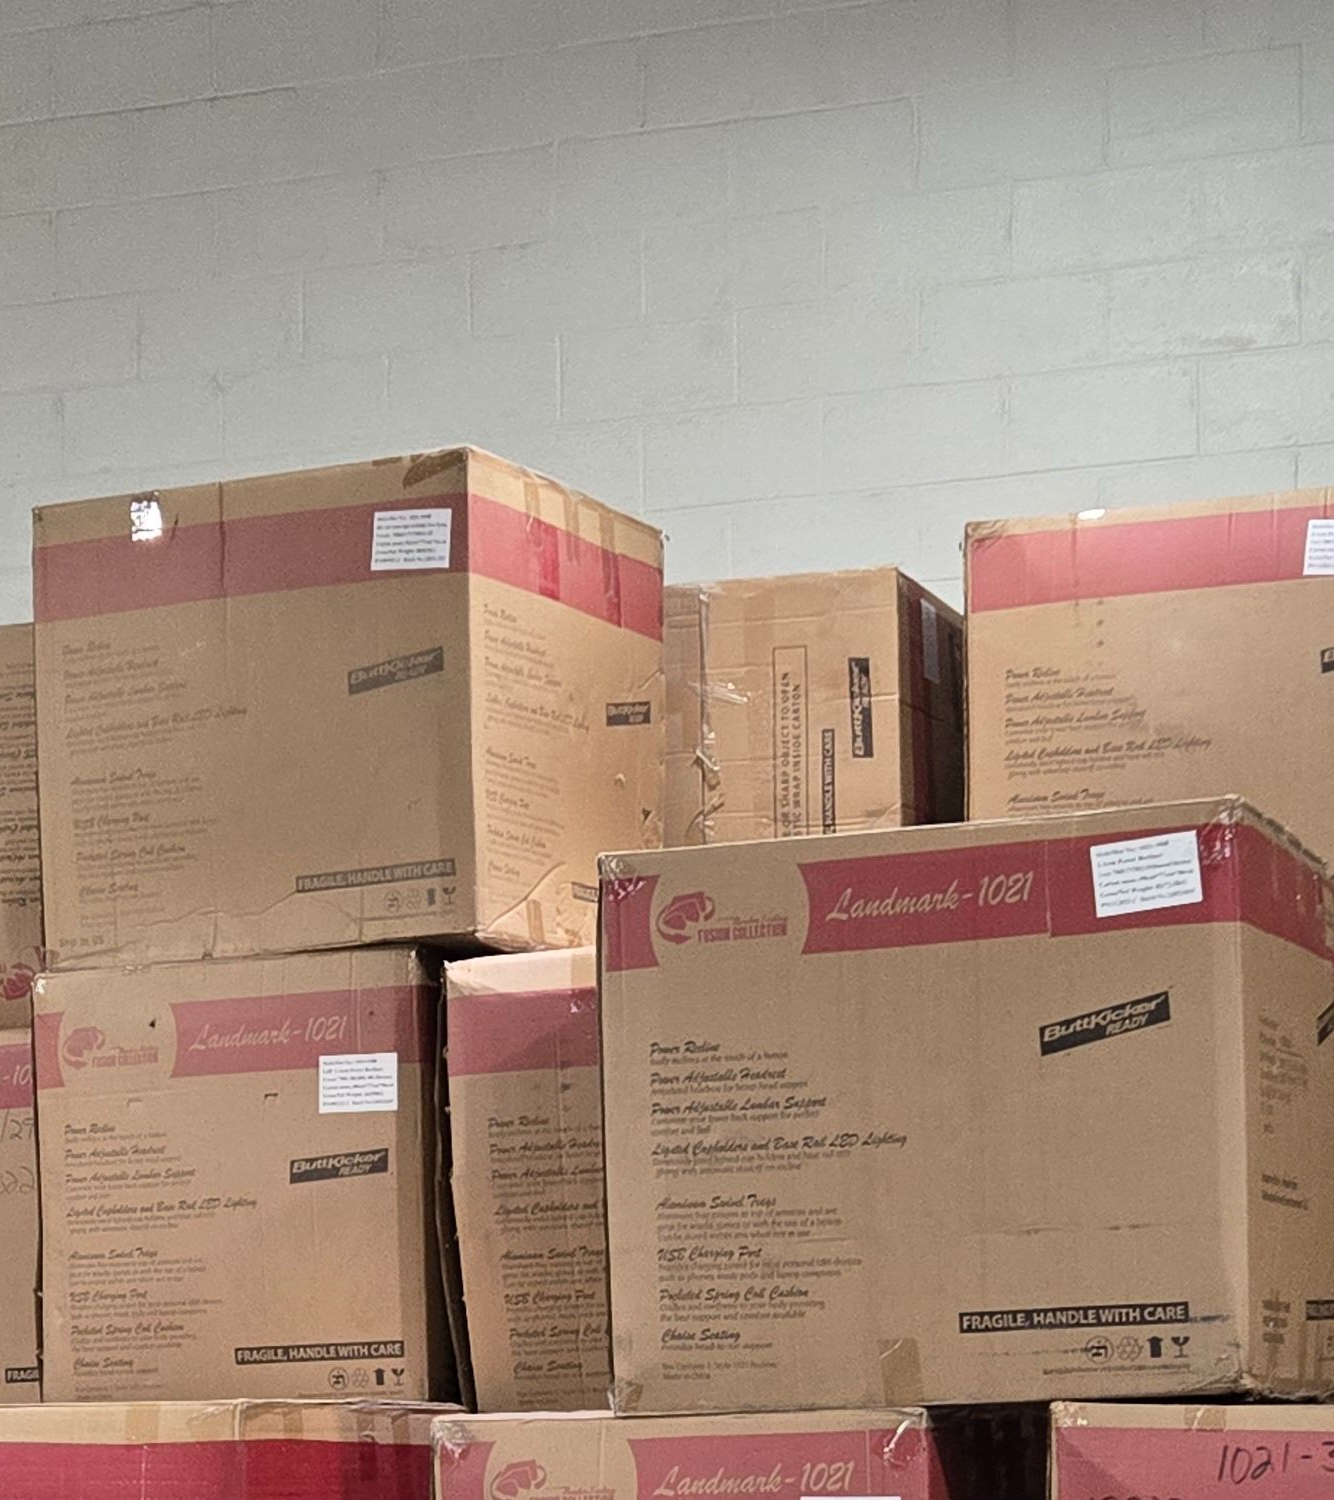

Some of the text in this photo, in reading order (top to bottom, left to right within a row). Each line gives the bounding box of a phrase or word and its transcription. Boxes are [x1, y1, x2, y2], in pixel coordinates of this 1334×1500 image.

[780, 672, 789, 703] OPEN
[780, 706, 789, 721] TO
[780, 725, 790, 767] OBJECT
[792, 684, 801, 809] WRAP INSIDE CARTON
[824, 730, 833, 784] WITH CARE
[781, 770, 790, 808] SHARP
[827, 870, 1035, 921] Landmark-1021
[733, 924, 787, 941] COLLECTION
[1044, 995, 1166, 1041] ButtKicker
[1107, 1012, 1148, 1035] READY
[189, 1016, 348, 1051] Landmark-1021
[650, 1042, 680, 1057] Power
[650, 1067, 787, 1086] Power Adjustable Headrest
[651, 1096, 827, 1116] Power Adjustable Lumbar Support
[750, 1138, 770, 1151] and
[773, 1136, 798, 1151] Base
[829, 1133, 859, 1149] LED
[862, 1132, 907, 1149] Lighting
[293, 1151, 386, 1173] ButtKicker
[338, 1163, 372, 1176] READY
[748, 1194, 777, 1209] Trays
[657, 1245, 763, 1262] USB Charging Port
[704, 1287, 741, 1302] Spring
[769, 1284, 809, 1301] Cushion
[962, 1302, 1187, 1331] FRAGILE, HANDLE WITH CARE
[661, 1327, 741, 1343] Chaise Seating
[237, 1343, 402, 1362] FRAGILE, HANDLE WITH CARE
[654, 1462, 856, 1498] Landmark-1021
